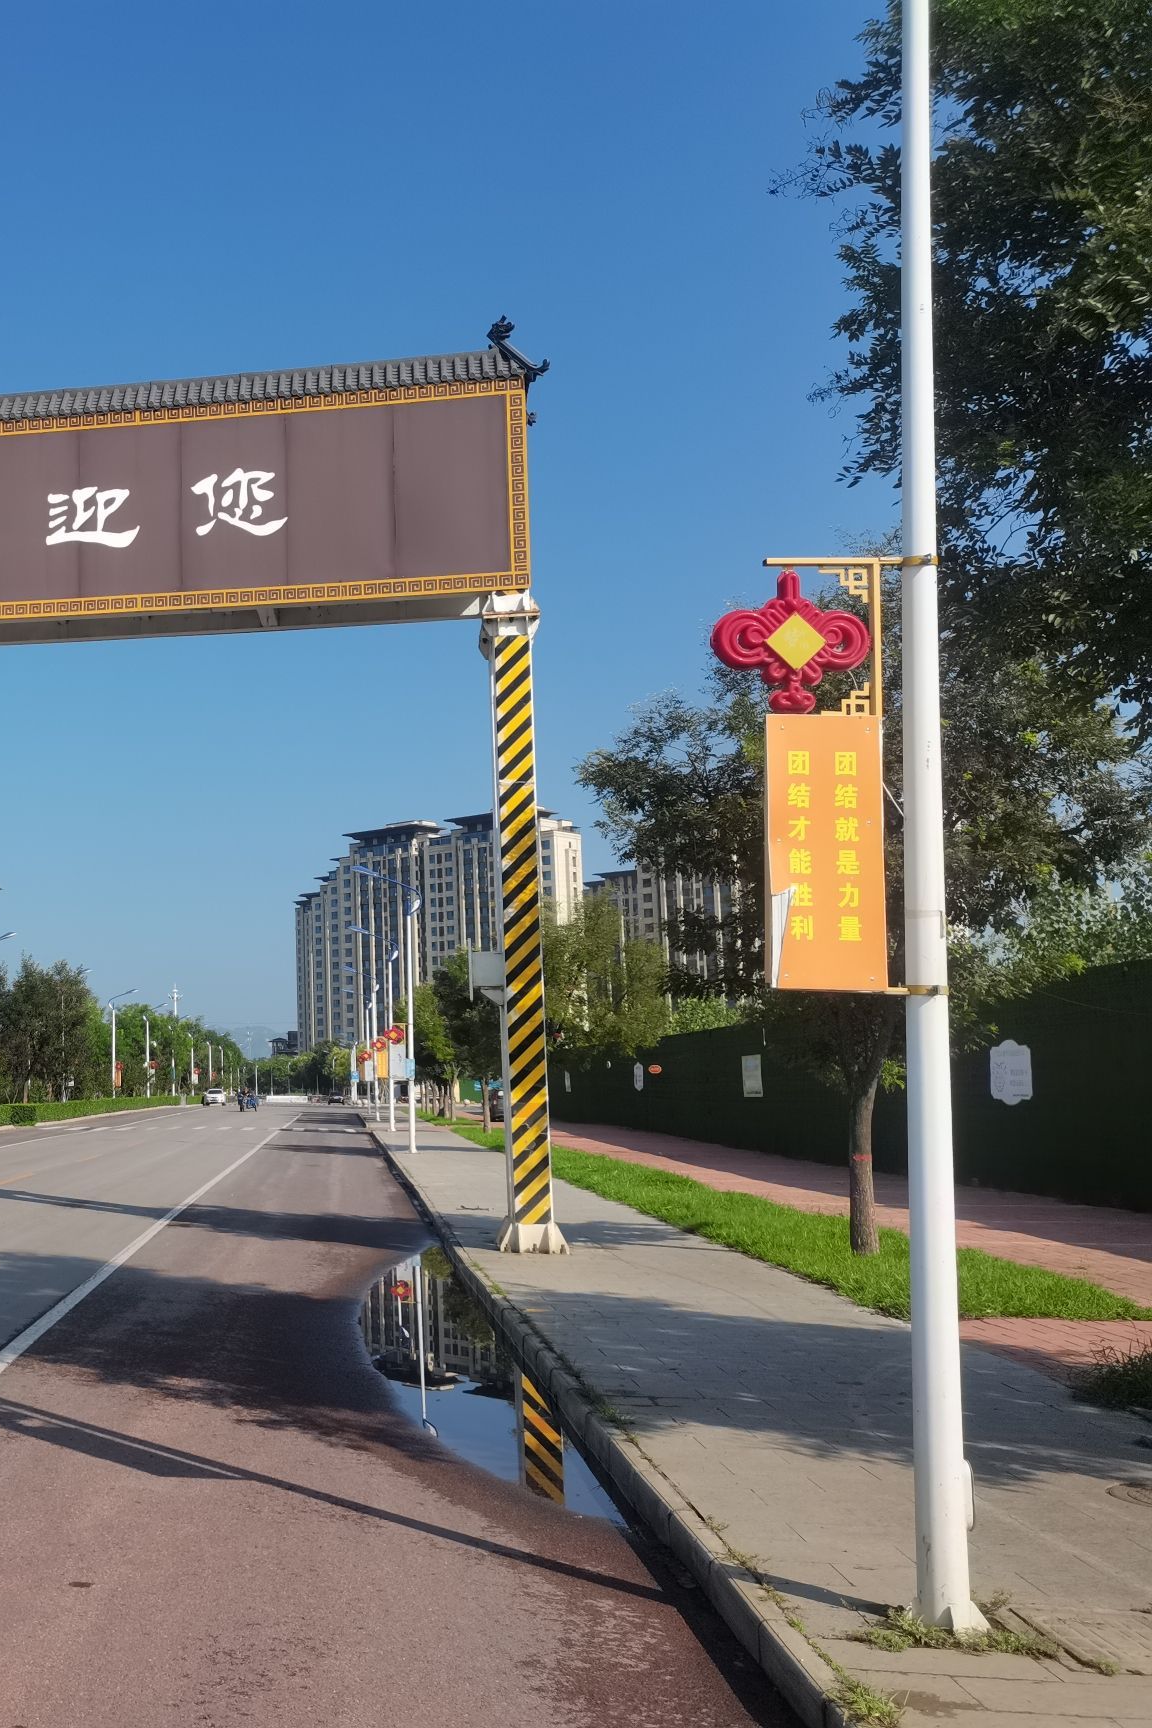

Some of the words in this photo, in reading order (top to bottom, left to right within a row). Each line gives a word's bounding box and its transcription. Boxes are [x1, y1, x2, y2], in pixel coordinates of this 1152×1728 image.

[786, 750, 815, 941] 团结才能胜利
[834, 751, 863, 942] 团结就是力量
